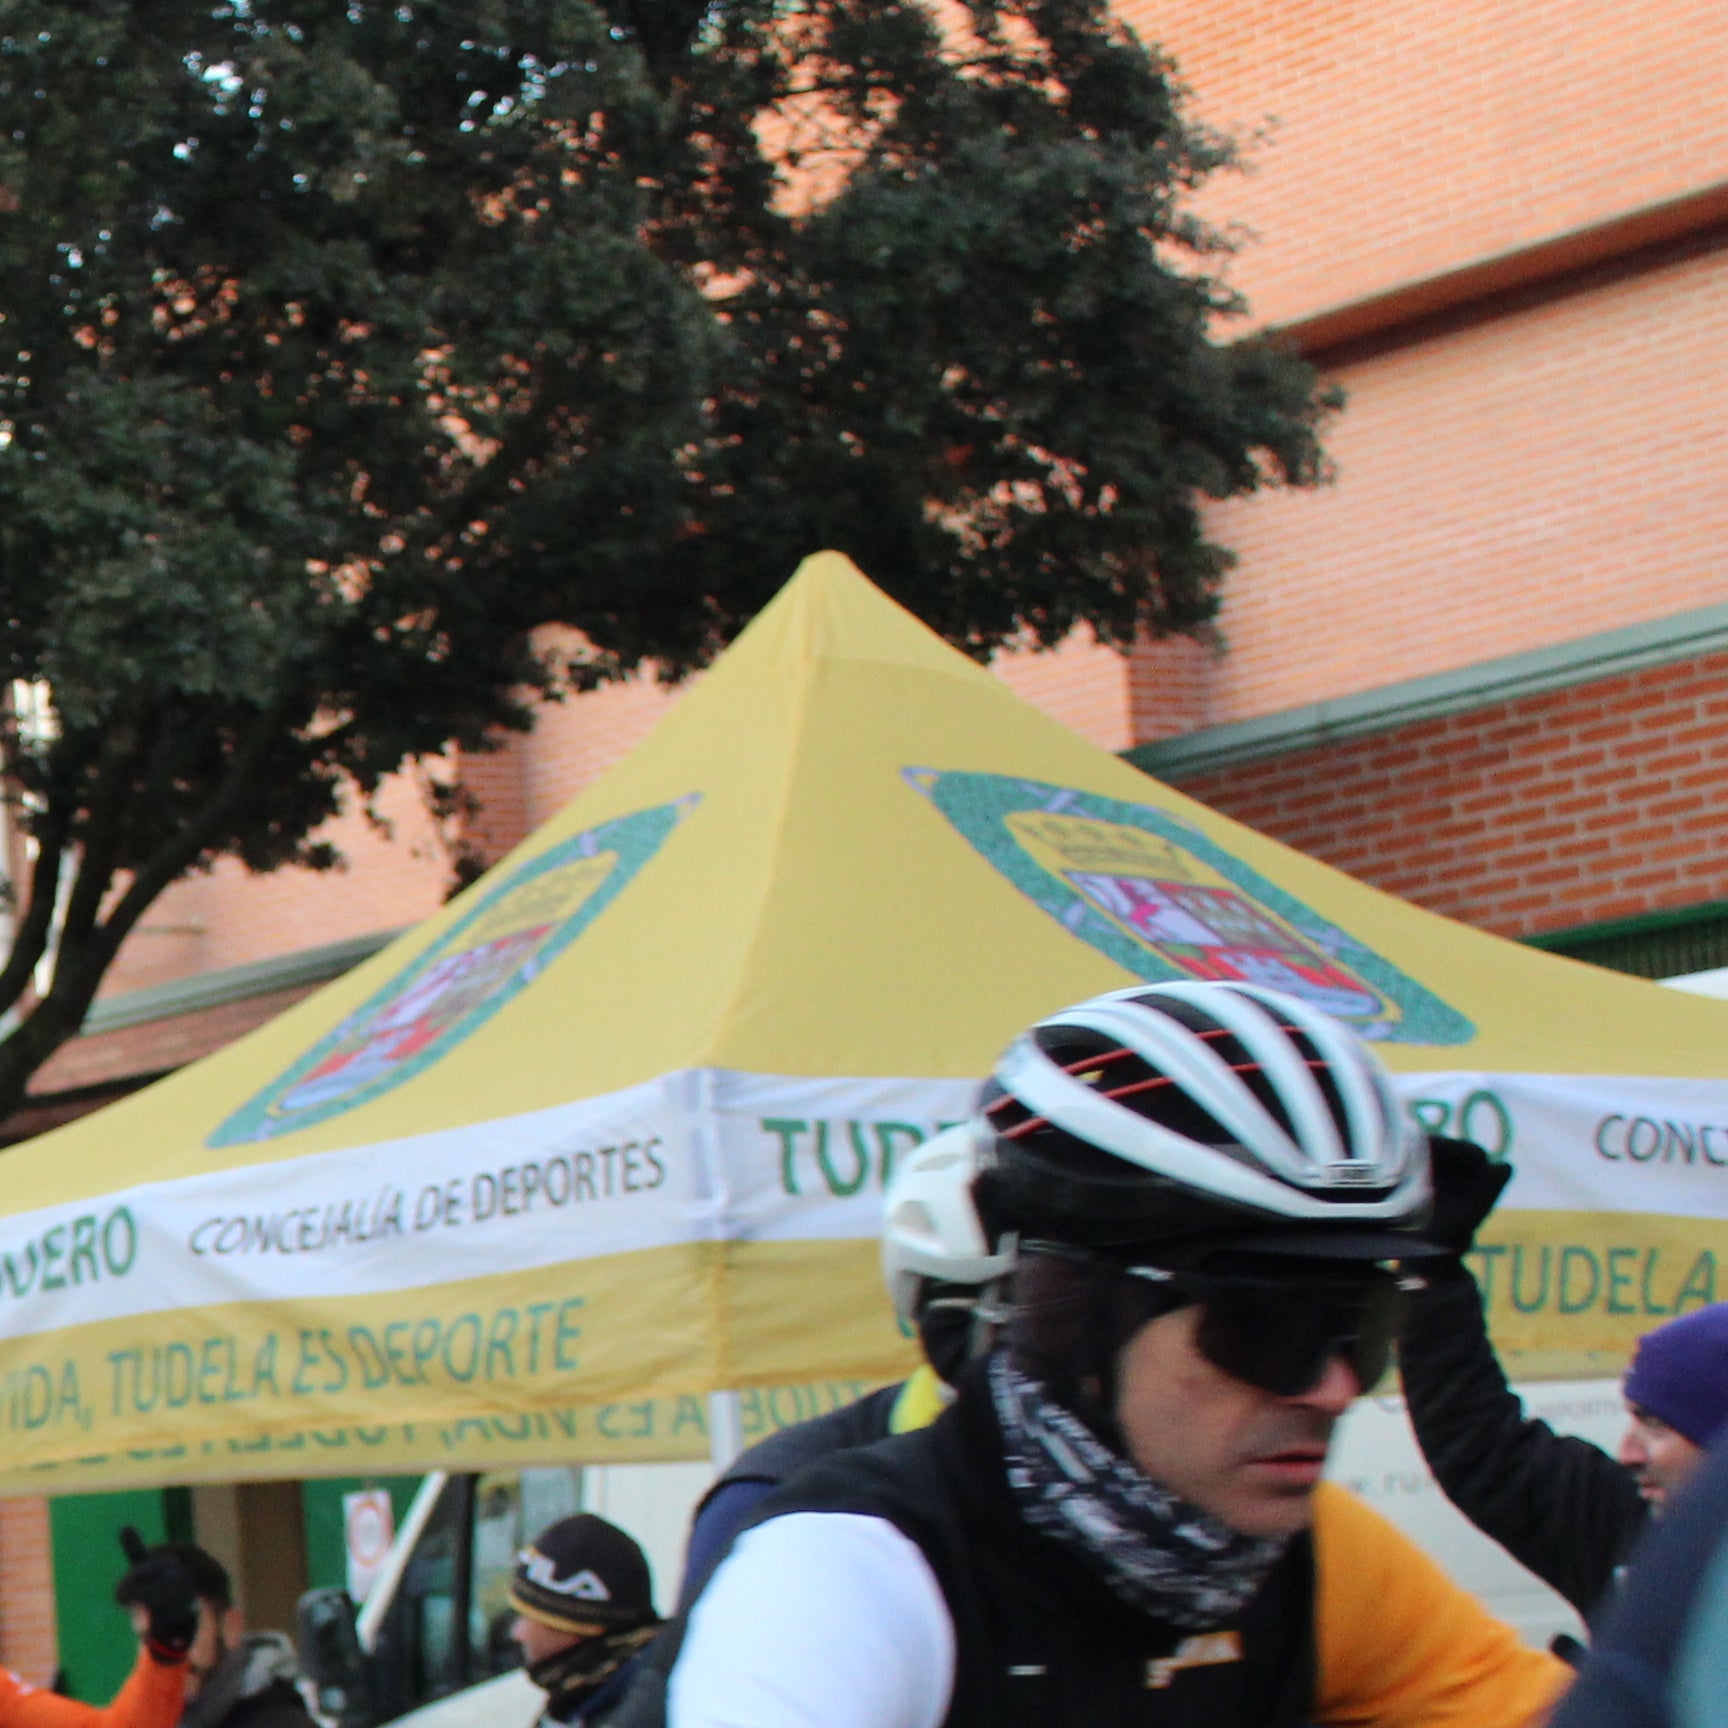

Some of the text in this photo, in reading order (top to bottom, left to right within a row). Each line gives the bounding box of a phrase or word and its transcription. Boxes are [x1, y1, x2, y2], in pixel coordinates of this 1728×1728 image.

[414, 1180, 463, 1233] DE
[471, 1137, 667, 1223] DEPORTES
[107, 1332, 278, 1417] TUDELA
[290, 1327, 351, 1393] ES
[347, 1298, 586, 1389] DEPORTE
